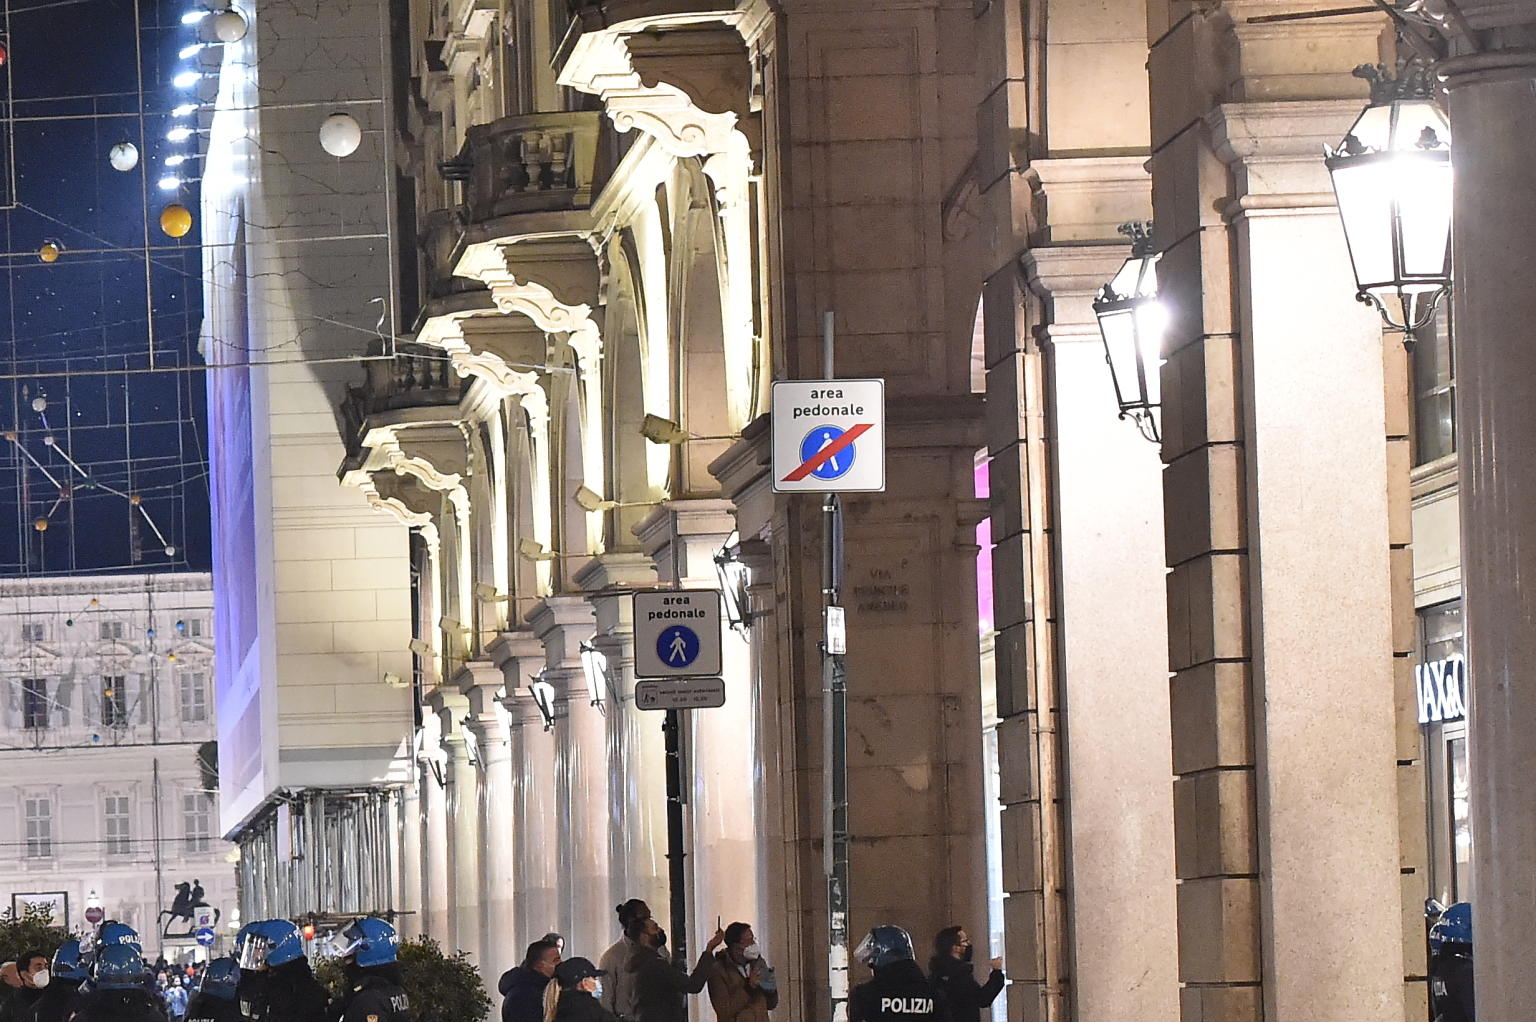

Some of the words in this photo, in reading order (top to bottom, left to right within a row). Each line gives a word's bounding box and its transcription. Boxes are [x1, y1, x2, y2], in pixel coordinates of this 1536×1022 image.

[810, 389, 843, 399] area
[793, 404, 864, 419] pedonale
[663, 597, 690, 605] area
[648, 608, 706, 621] pedonale
[881, 997, 934, 1014] POLIZIA
